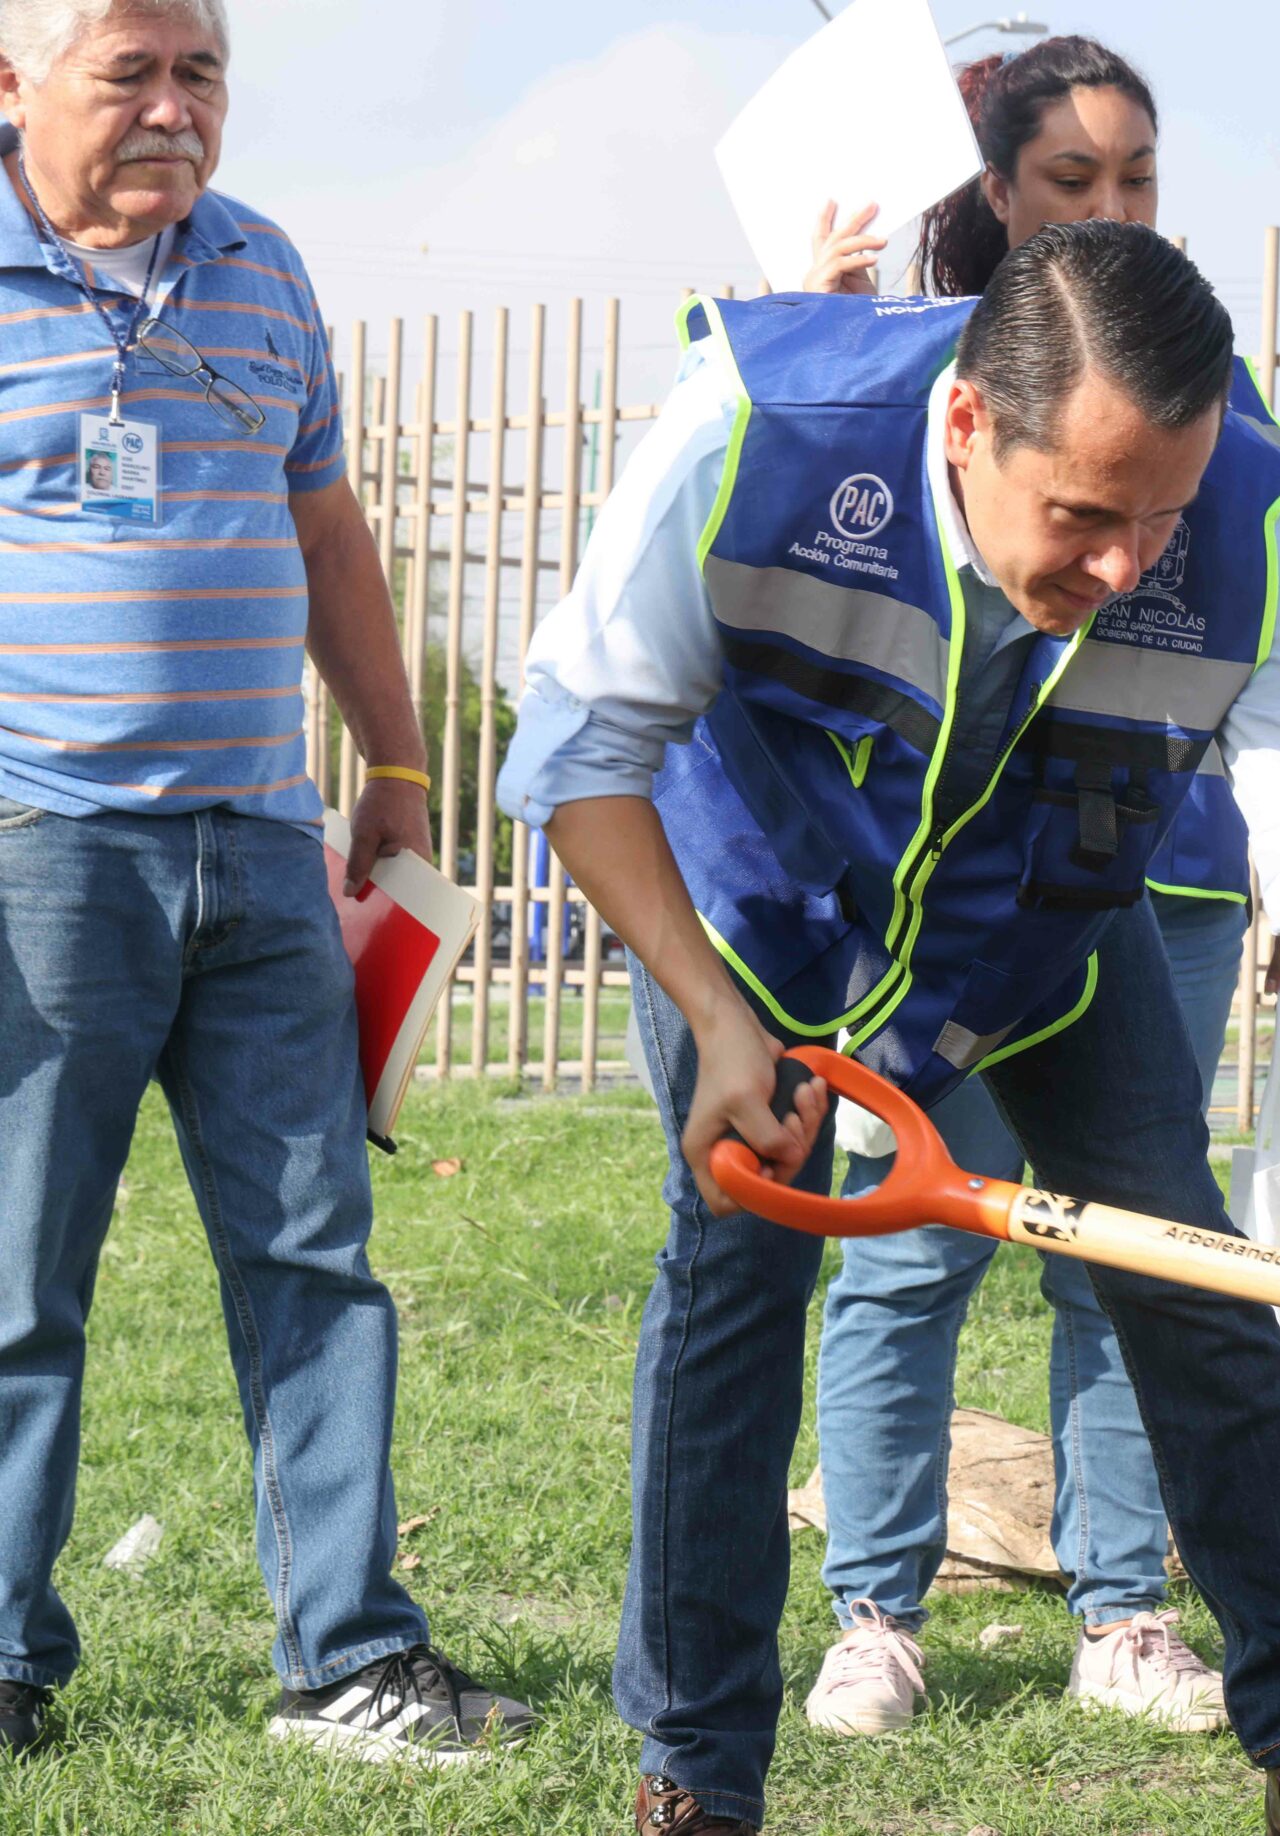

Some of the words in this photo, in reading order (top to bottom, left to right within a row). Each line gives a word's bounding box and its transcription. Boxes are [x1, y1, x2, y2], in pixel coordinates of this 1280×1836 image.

[126, 437, 141, 449] PAC
[838, 485, 885, 527] PAC
[814, 530, 888, 560] Programa
[788, 542, 830, 564] Acción
[833, 554, 899, 579] Comunitaria
[1097, 617, 1109, 626] DE
[1111, 619, 1127, 629] LOS
[1130, 621, 1156, 634] GARZA
[1100, 602, 1131, 619] SAN
[1139, 608, 1206, 631] NICOLÁS
[1096, 628, 1138, 641] GOBIERNO
[1141, 635, 1153, 645] DE
[1157, 637, 1168, 647] LA
[1171, 639, 1203, 652] CIUDAD
